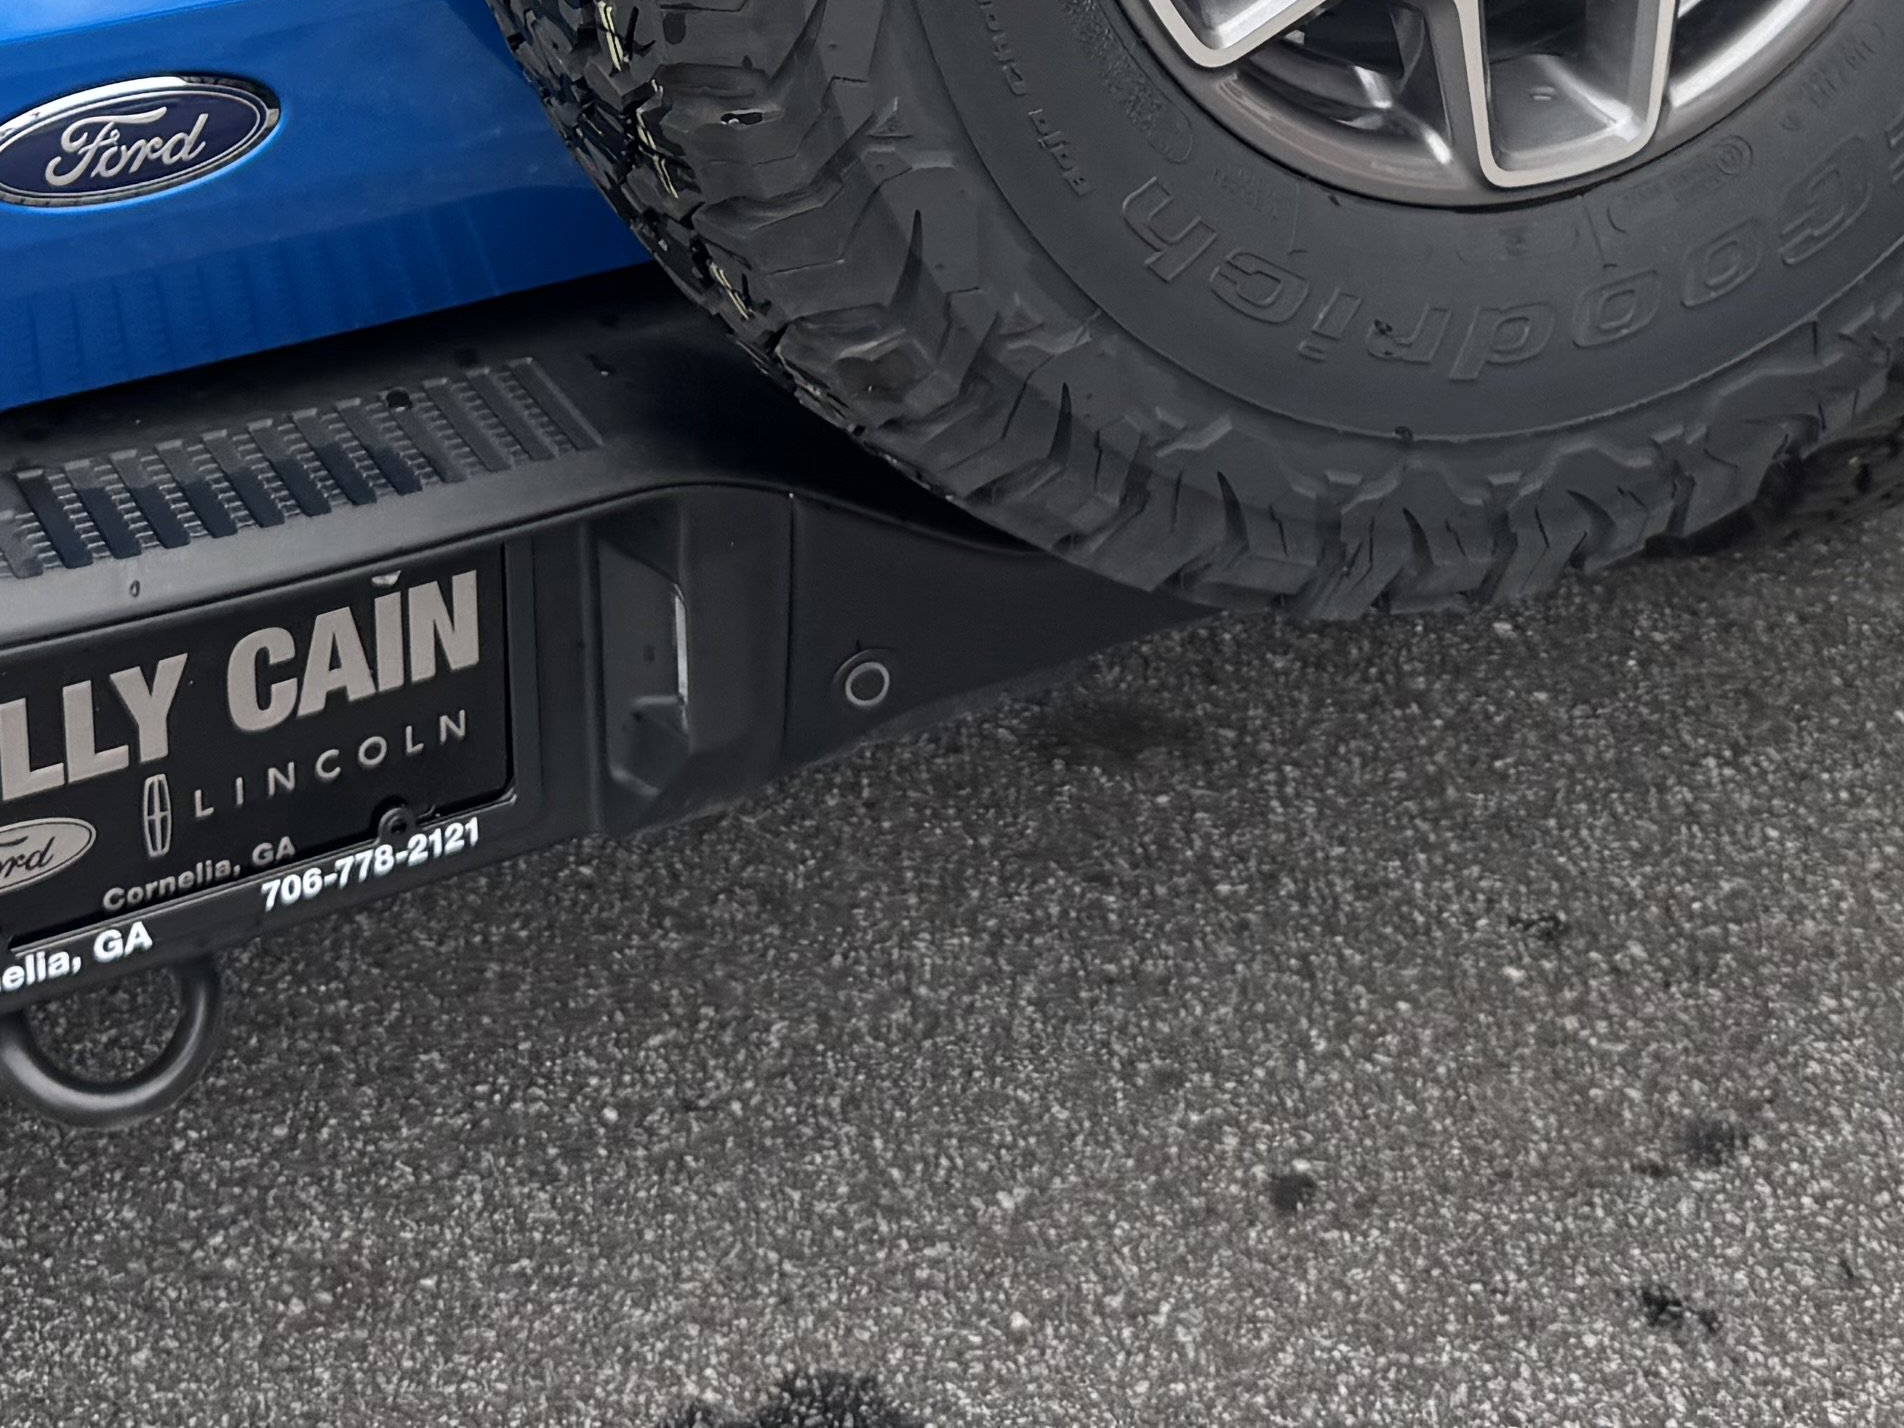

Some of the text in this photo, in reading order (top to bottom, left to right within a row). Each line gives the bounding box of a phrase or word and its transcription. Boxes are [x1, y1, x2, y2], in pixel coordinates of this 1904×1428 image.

[45, 106, 209, 187] Ford
[226, 569, 480, 733] CAIN
[195, 708, 468, 820] LINCOLN
[102, 836, 296, 912] Cornelia, GA
[261, 817, 481, 911] 706-778-2121
[93, 921, 154, 963] GA
